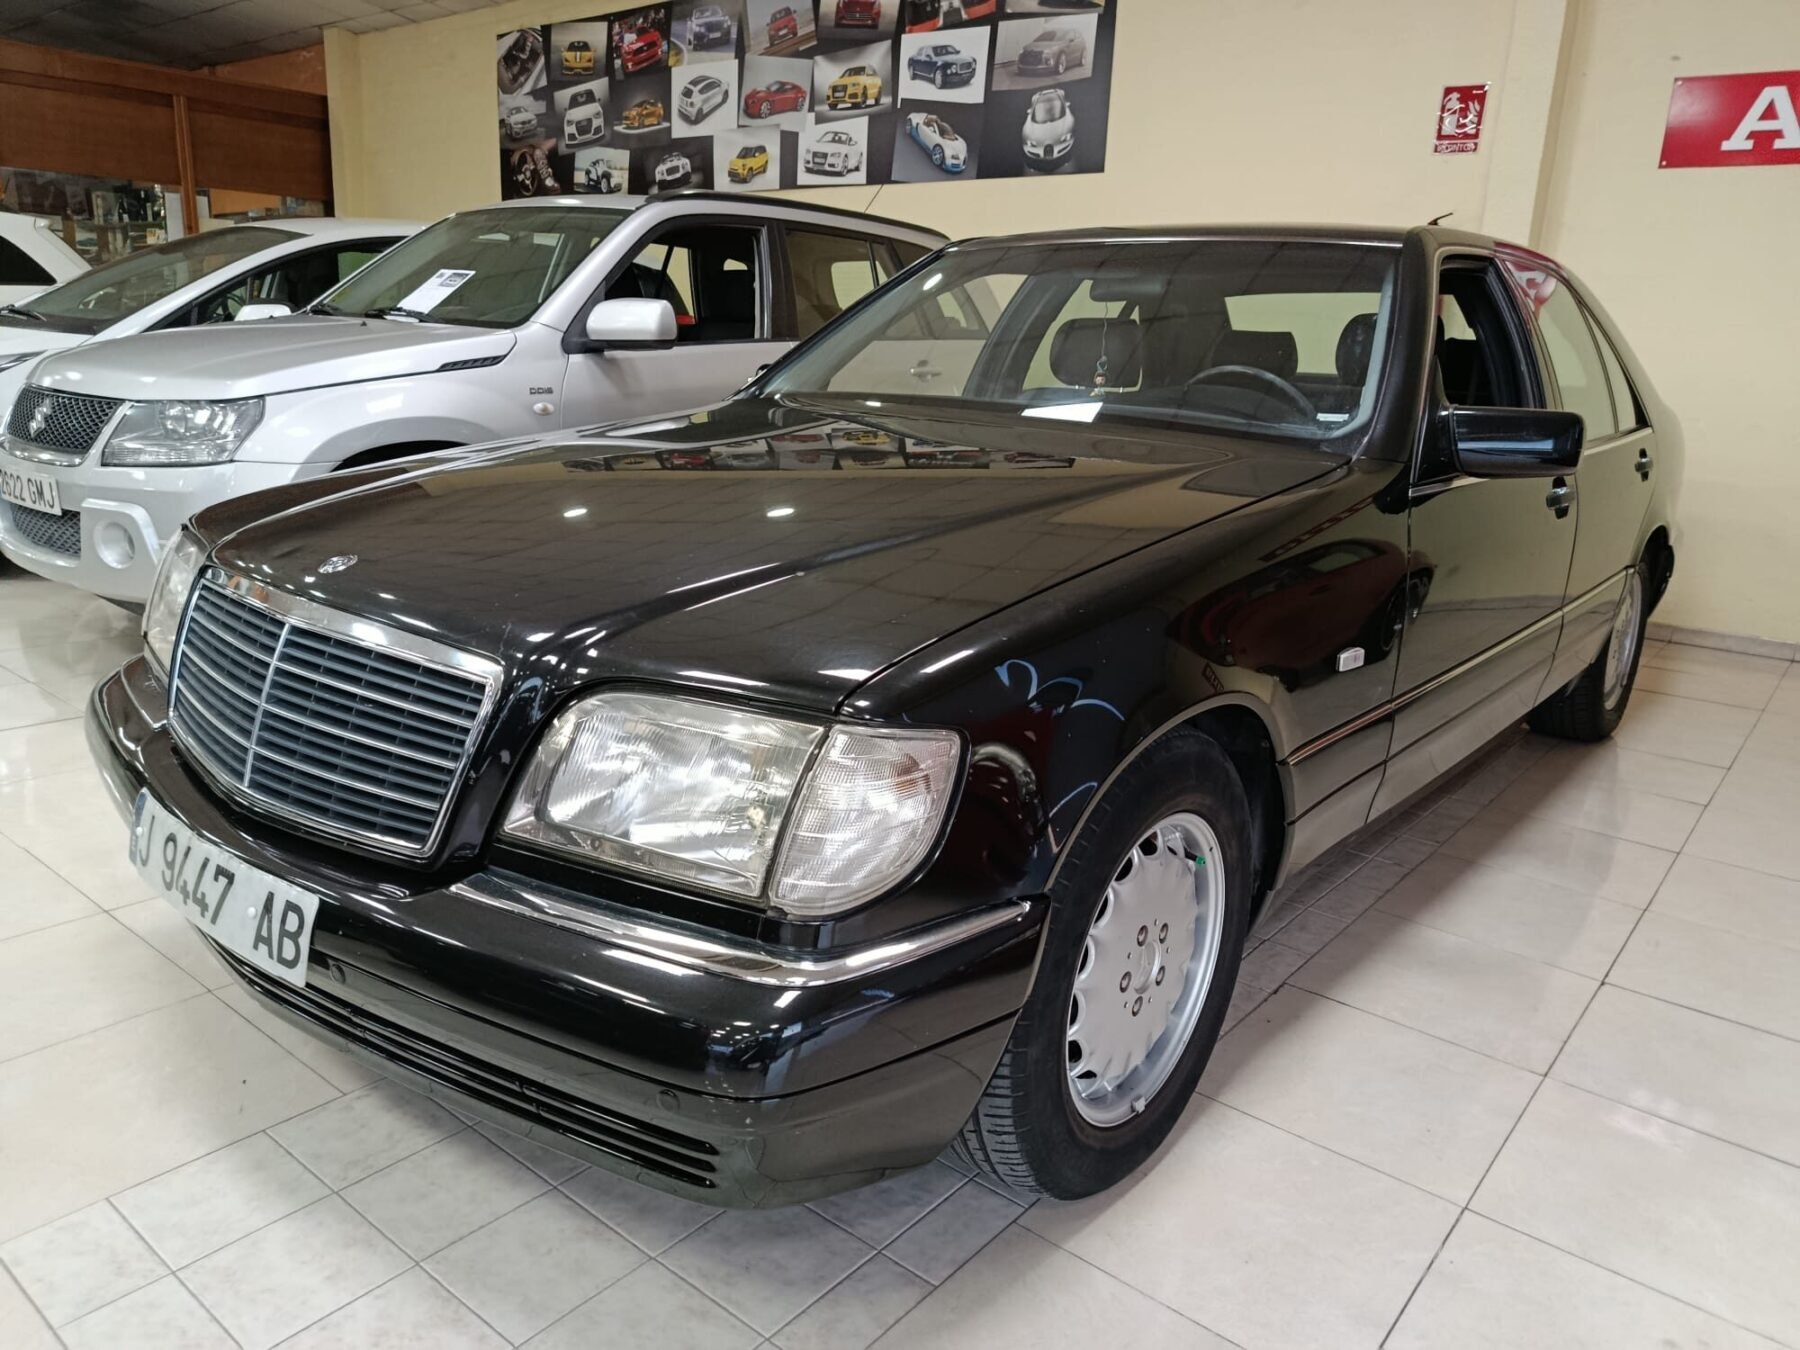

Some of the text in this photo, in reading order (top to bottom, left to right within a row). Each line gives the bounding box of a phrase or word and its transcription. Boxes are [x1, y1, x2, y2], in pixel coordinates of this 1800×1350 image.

[1720, 86, 1800, 151] A
[0, 469, 55, 509] 2622 GMJ
[138, 815, 305, 969] J 9447 AB
